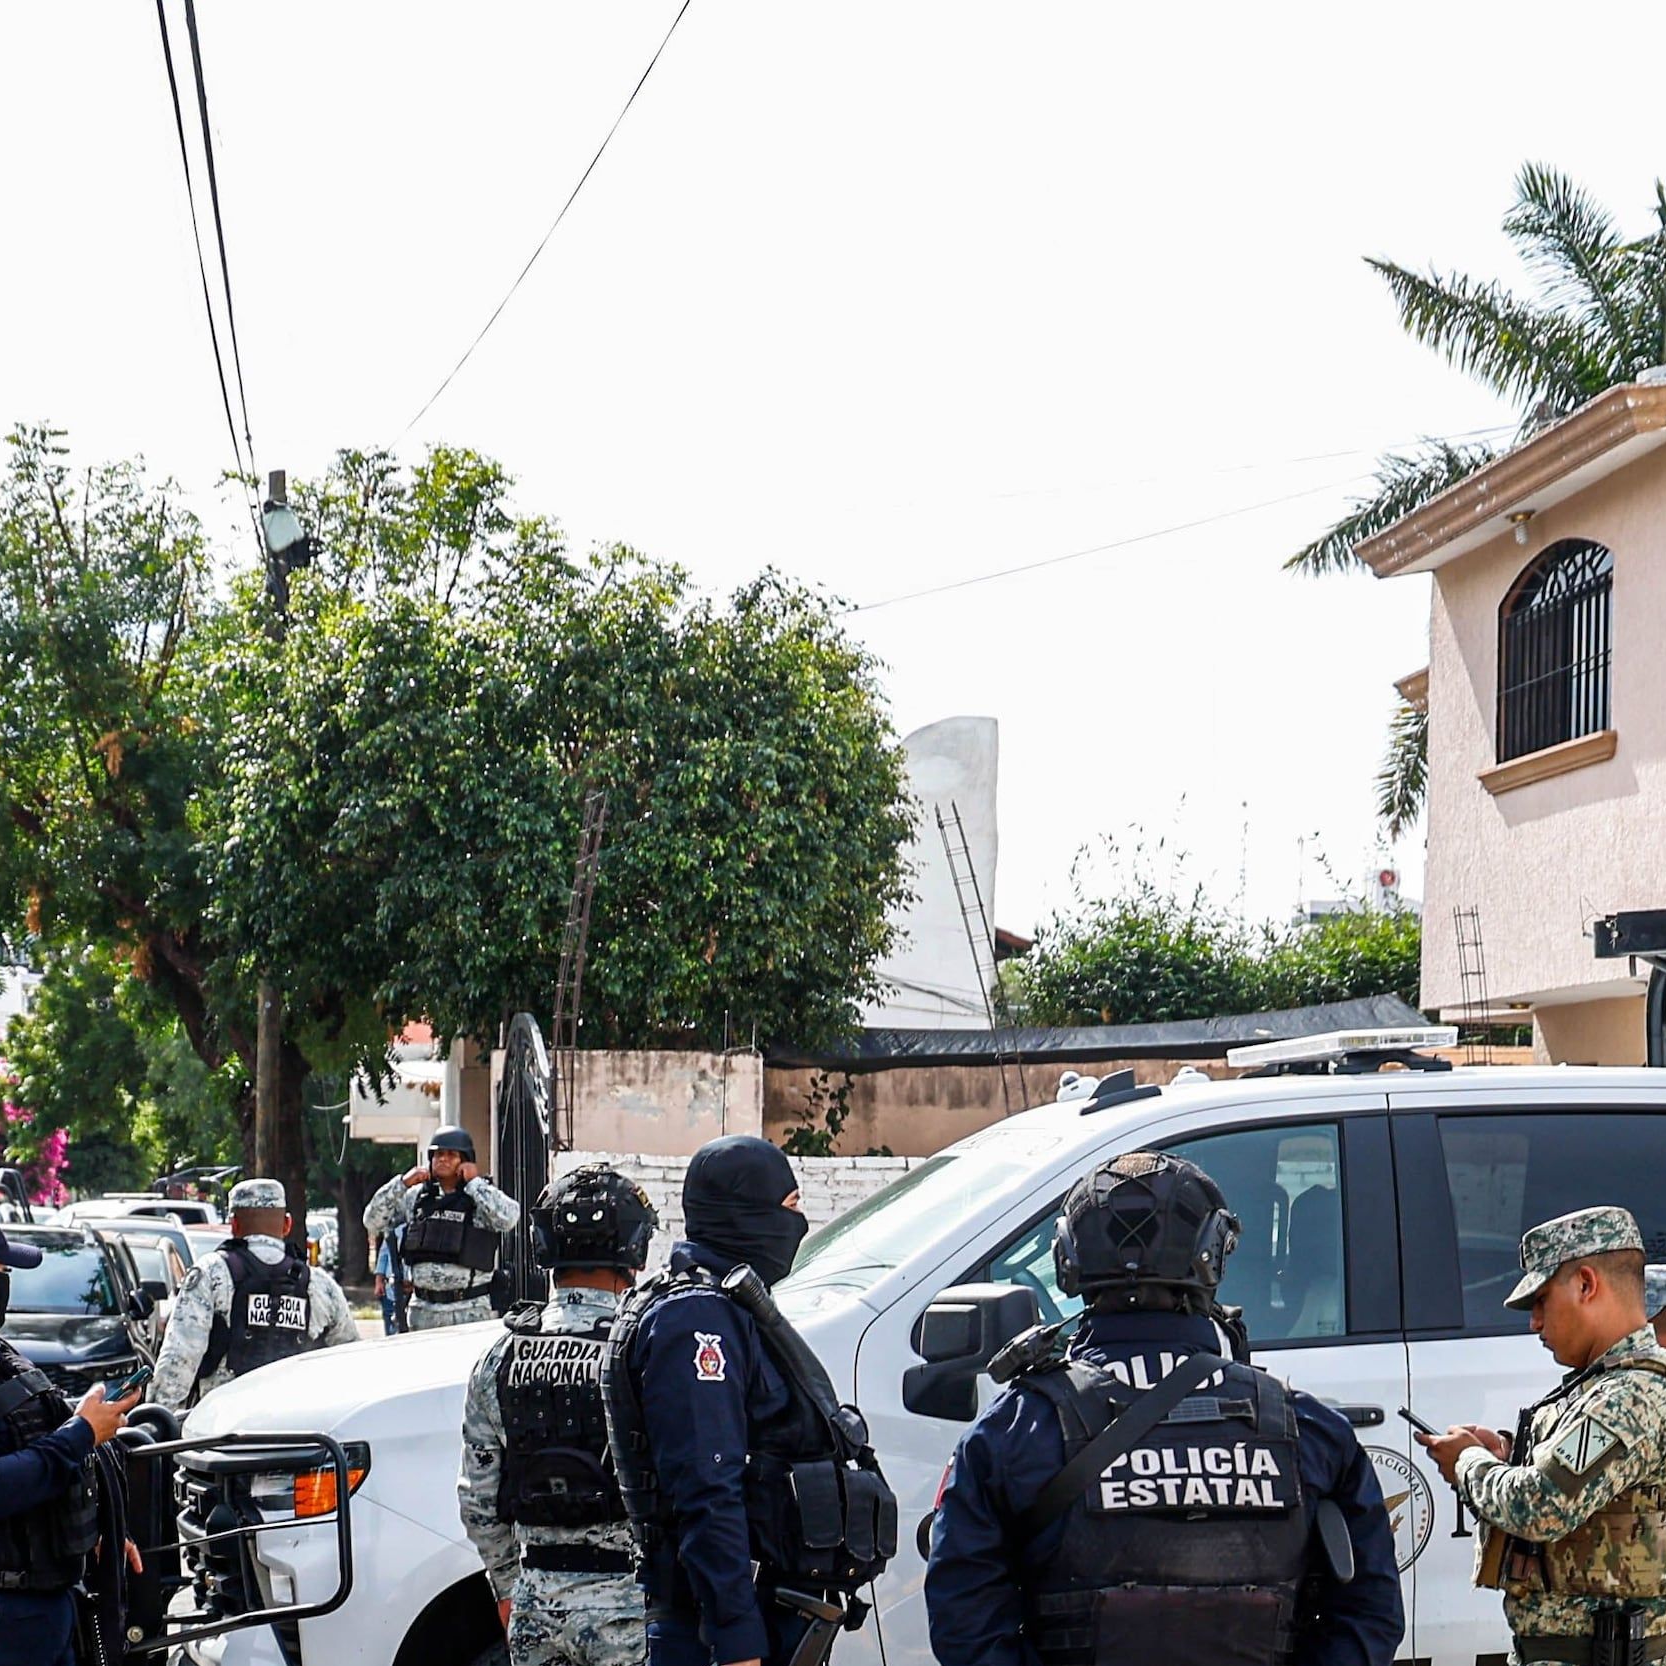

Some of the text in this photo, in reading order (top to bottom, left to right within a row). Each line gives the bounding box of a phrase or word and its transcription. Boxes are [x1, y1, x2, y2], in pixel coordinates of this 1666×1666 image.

[254, 1297, 301, 1312] GURDIA
[250, 1310, 305, 1327] NACONAL
[518, 1340, 601, 1361] GUARDIA
[512, 1362, 598, 1384] NACIONAL
[1100, 1442, 1281, 1478] POLICÍA
[1100, 1477, 1285, 1509] ESTATAL
